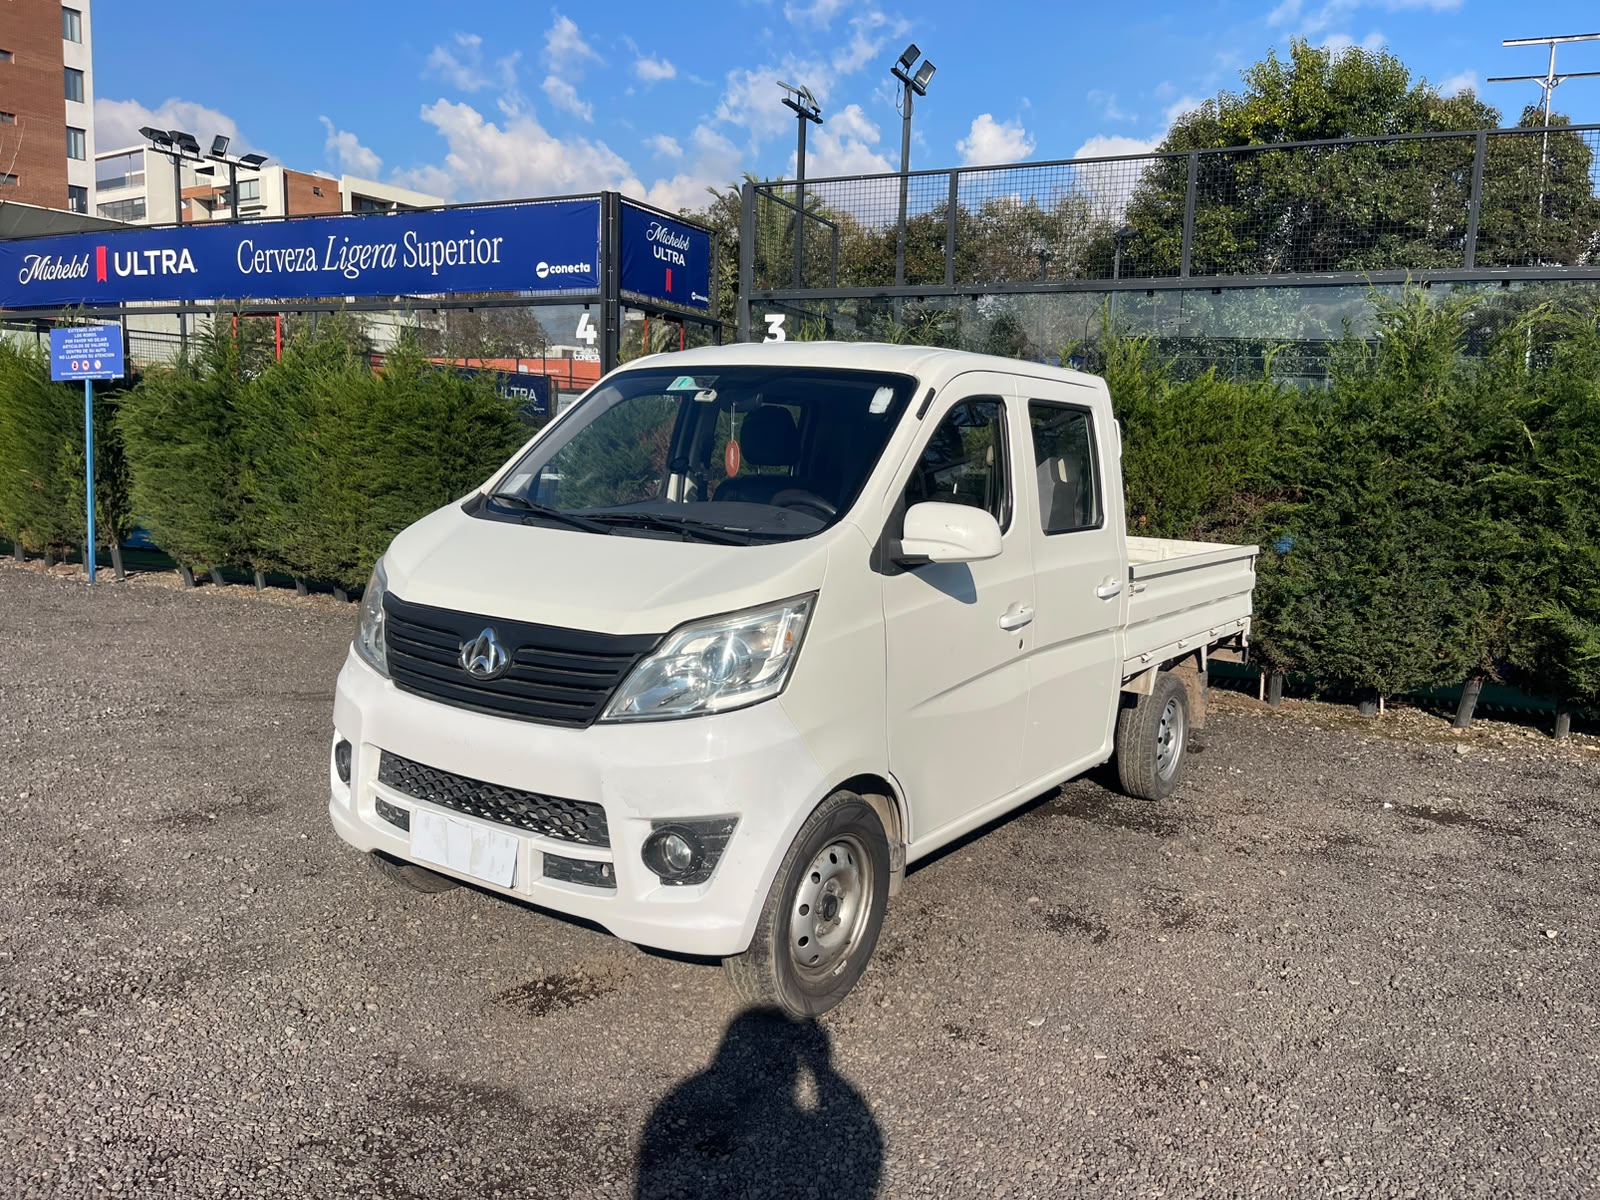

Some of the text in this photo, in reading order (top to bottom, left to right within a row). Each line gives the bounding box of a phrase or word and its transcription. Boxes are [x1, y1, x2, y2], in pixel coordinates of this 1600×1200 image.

[646, 221, 690, 251] Michelob
[18, 248, 197, 285] Michelob ULTRA
[237, 229, 503, 279] Cerveza Ligera Superior
[549, 262, 591, 274] conecta
[653, 245, 686, 267] ULTRA
[575, 313, 598, 345] 4
[762, 313, 786, 343] 3
